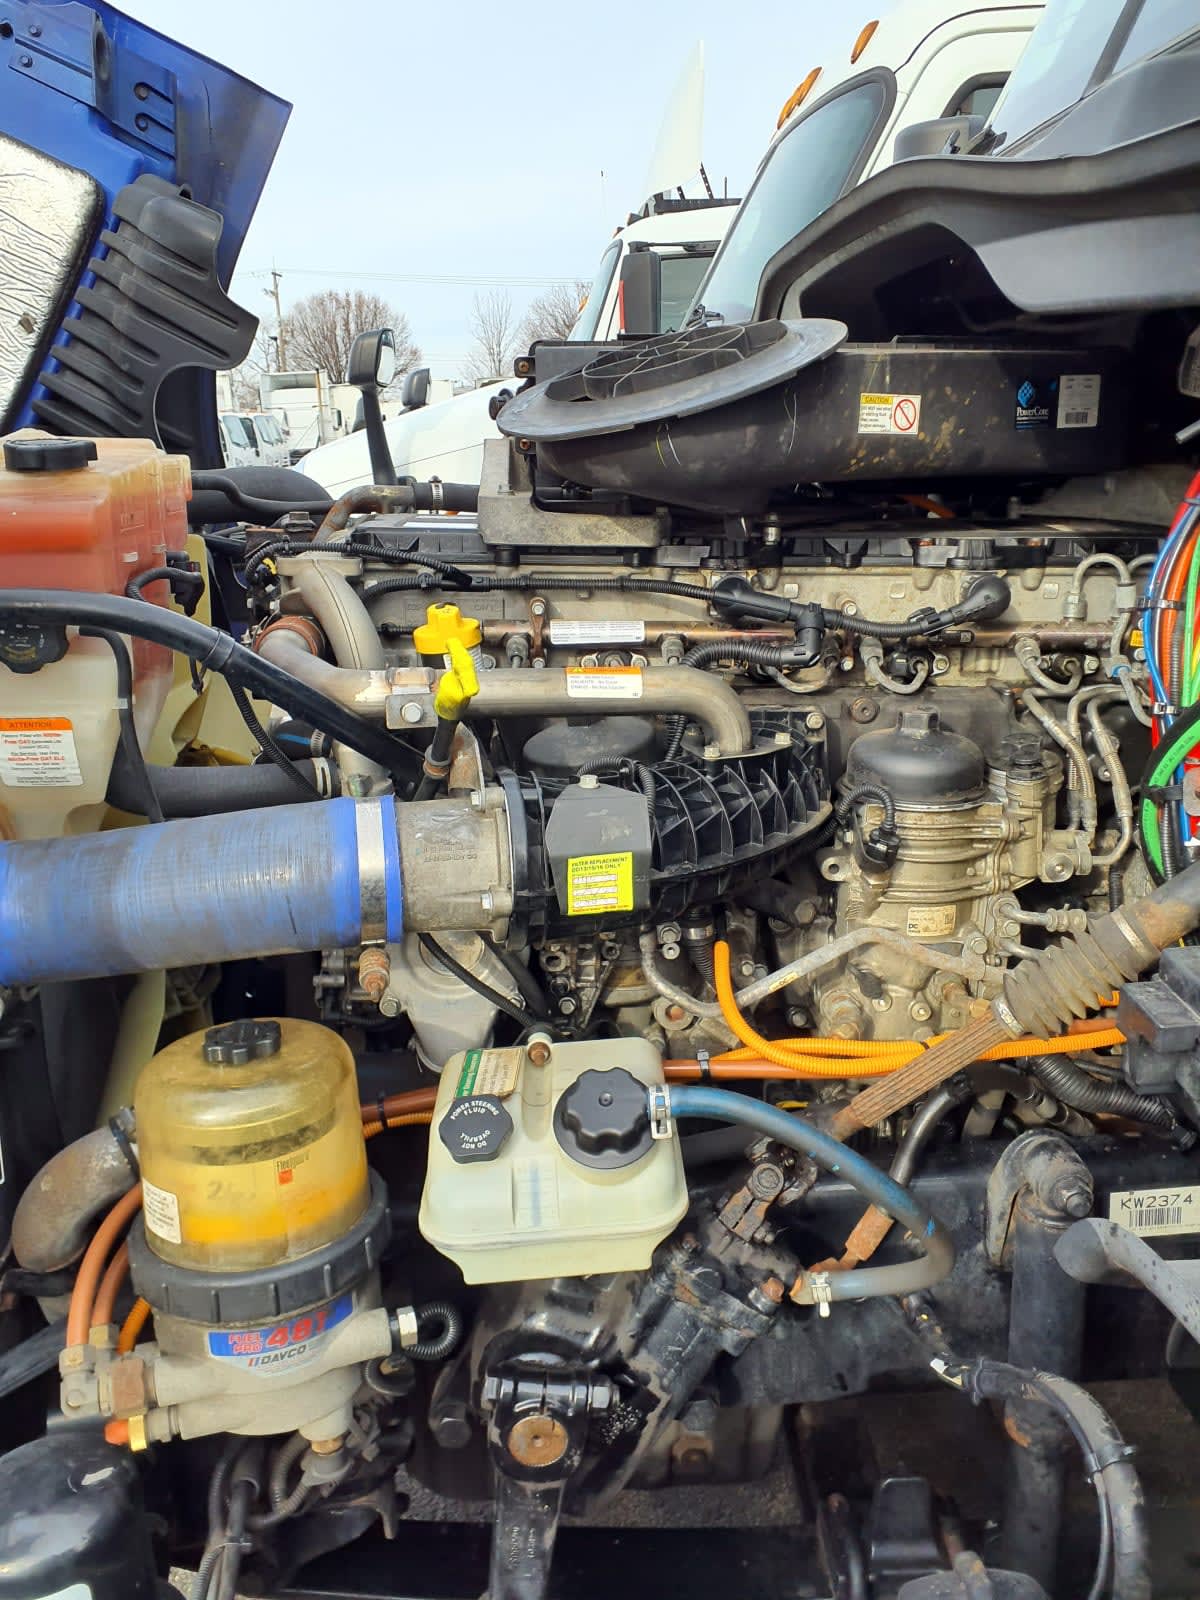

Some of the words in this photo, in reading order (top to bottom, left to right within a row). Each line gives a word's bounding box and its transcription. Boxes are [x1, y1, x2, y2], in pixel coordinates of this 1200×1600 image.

[1016, 406, 1049, 417] PowerCore
[8, 721, 52, 729] ATTENTION
[450, 1101, 470, 1120] POWER
[471, 1100, 499, 1116] STEERING
[463, 1106, 486, 1116] FLUID
[460, 1130, 491, 1142] OVERFILL
[461, 1141, 475, 1150] NOT
[477, 1140, 488, 1148] DO
[1120, 1192, 1193, 1211] KW2374
[228, 1331, 264, 1345] FUEL
[232, 1342, 263, 1355] PRO
[260, 1344, 308, 1365] DAVCO
